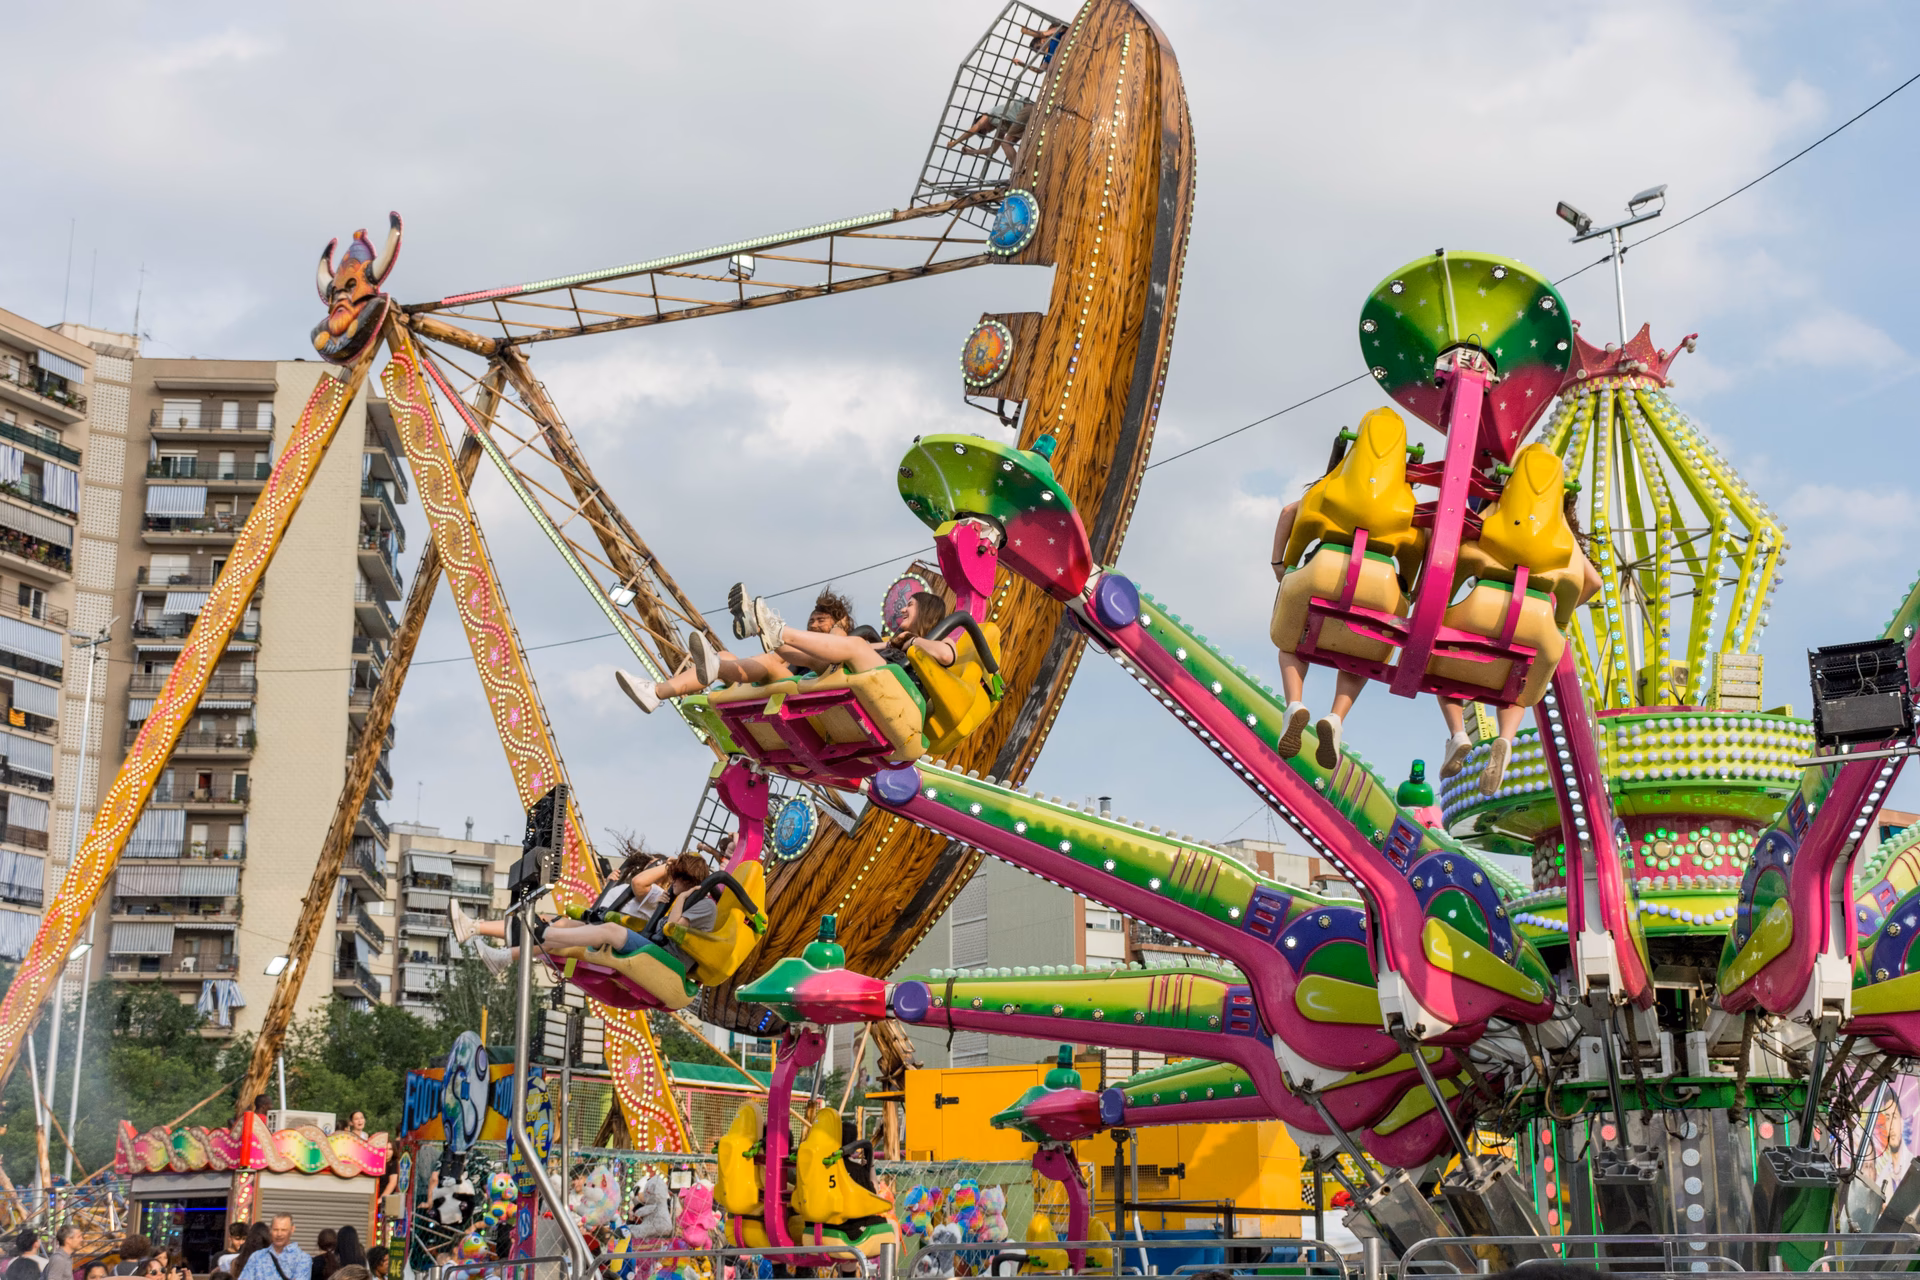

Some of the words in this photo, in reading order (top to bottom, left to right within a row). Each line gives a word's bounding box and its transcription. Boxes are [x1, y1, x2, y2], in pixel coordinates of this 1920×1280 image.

[402, 1072, 443, 1137] FOOT
[829, 1174, 836, 1189] 5
[390, 1259, 402, 1278] 4€
